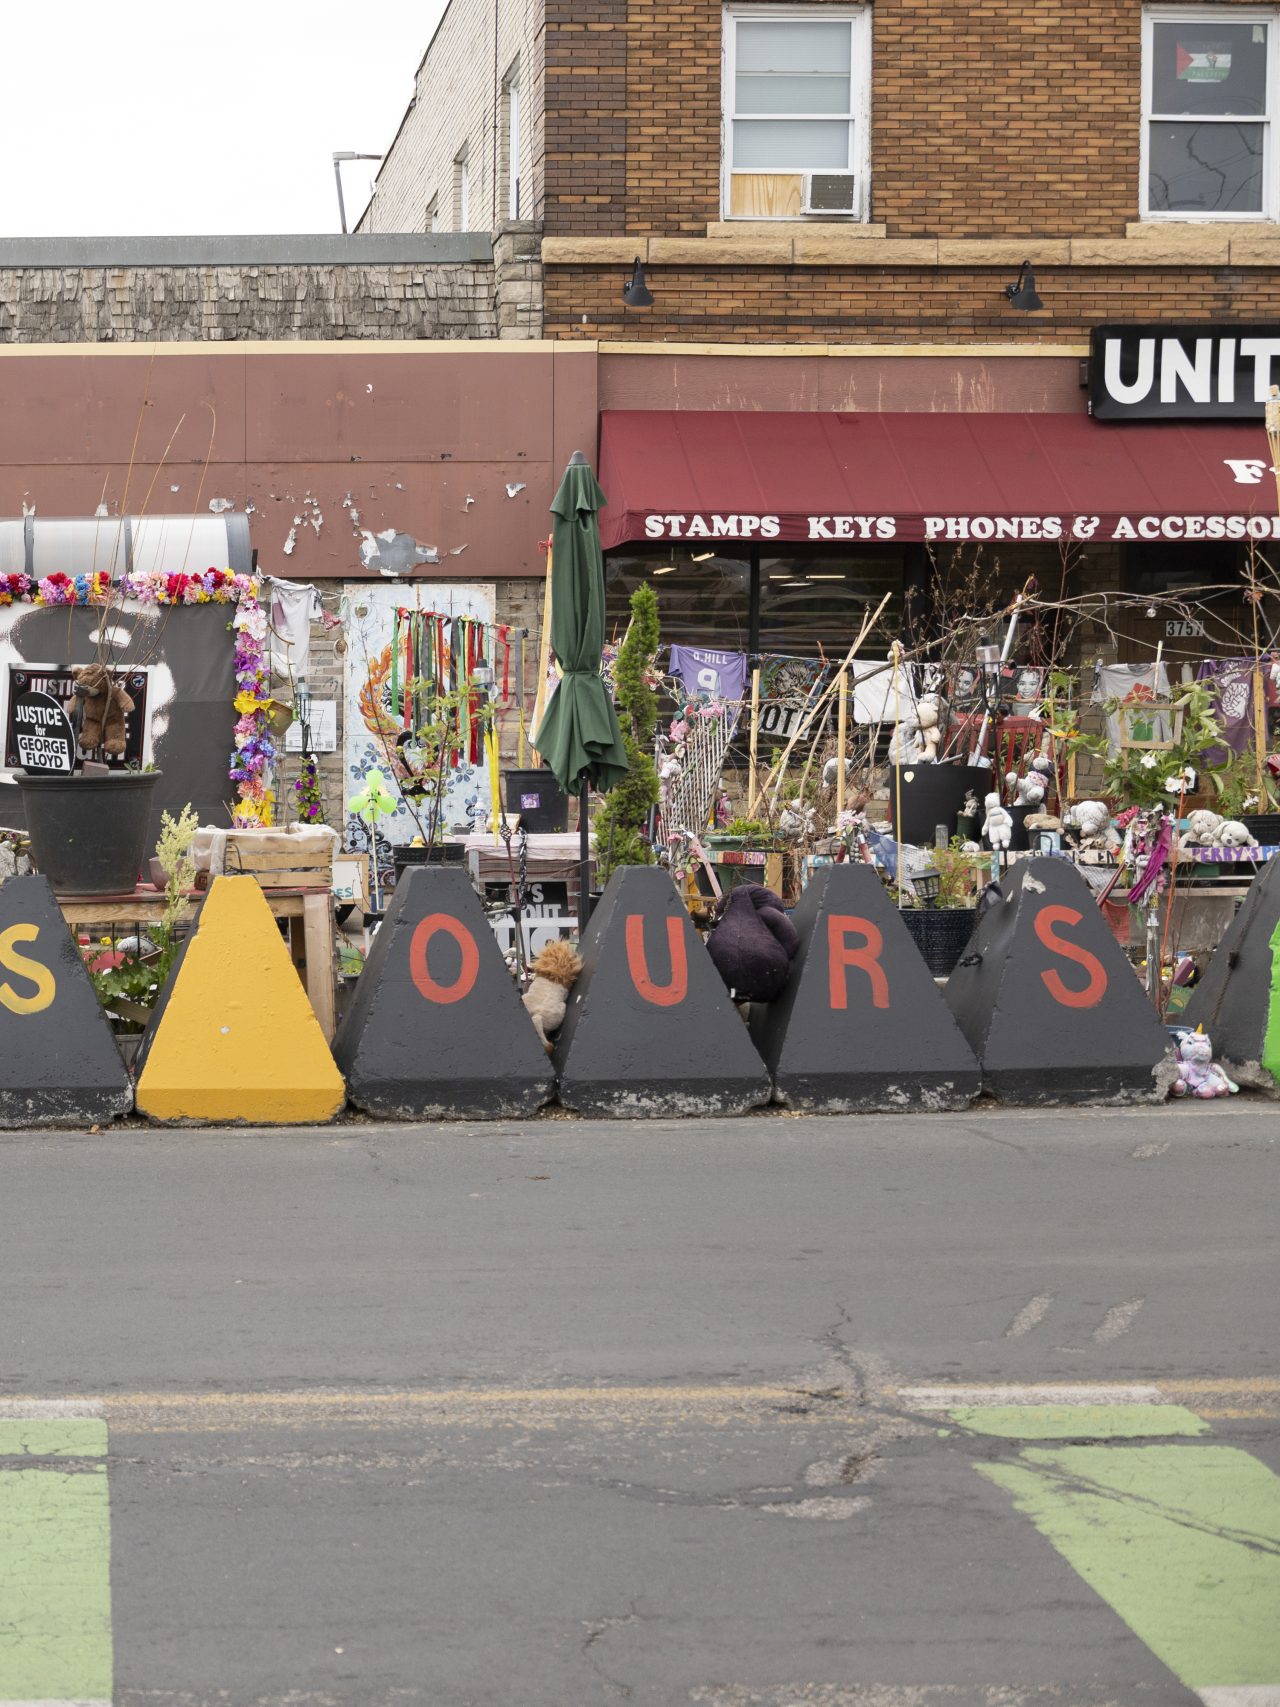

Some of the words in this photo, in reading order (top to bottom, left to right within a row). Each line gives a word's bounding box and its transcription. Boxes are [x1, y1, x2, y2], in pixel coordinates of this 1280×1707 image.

[645, 514, 780, 538] STAMPS
[807, 515, 896, 540] KEYS
[924, 515, 1062, 540] PHONES
[1072, 515, 1099, 540] &
[697, 667, 718, 691] 9
[16, 705, 62, 726] JUSTICE
[35, 725, 46, 736] for
[20, 737, 67, 755] GEORGE
[26, 752, 63, 768] FLOYD
